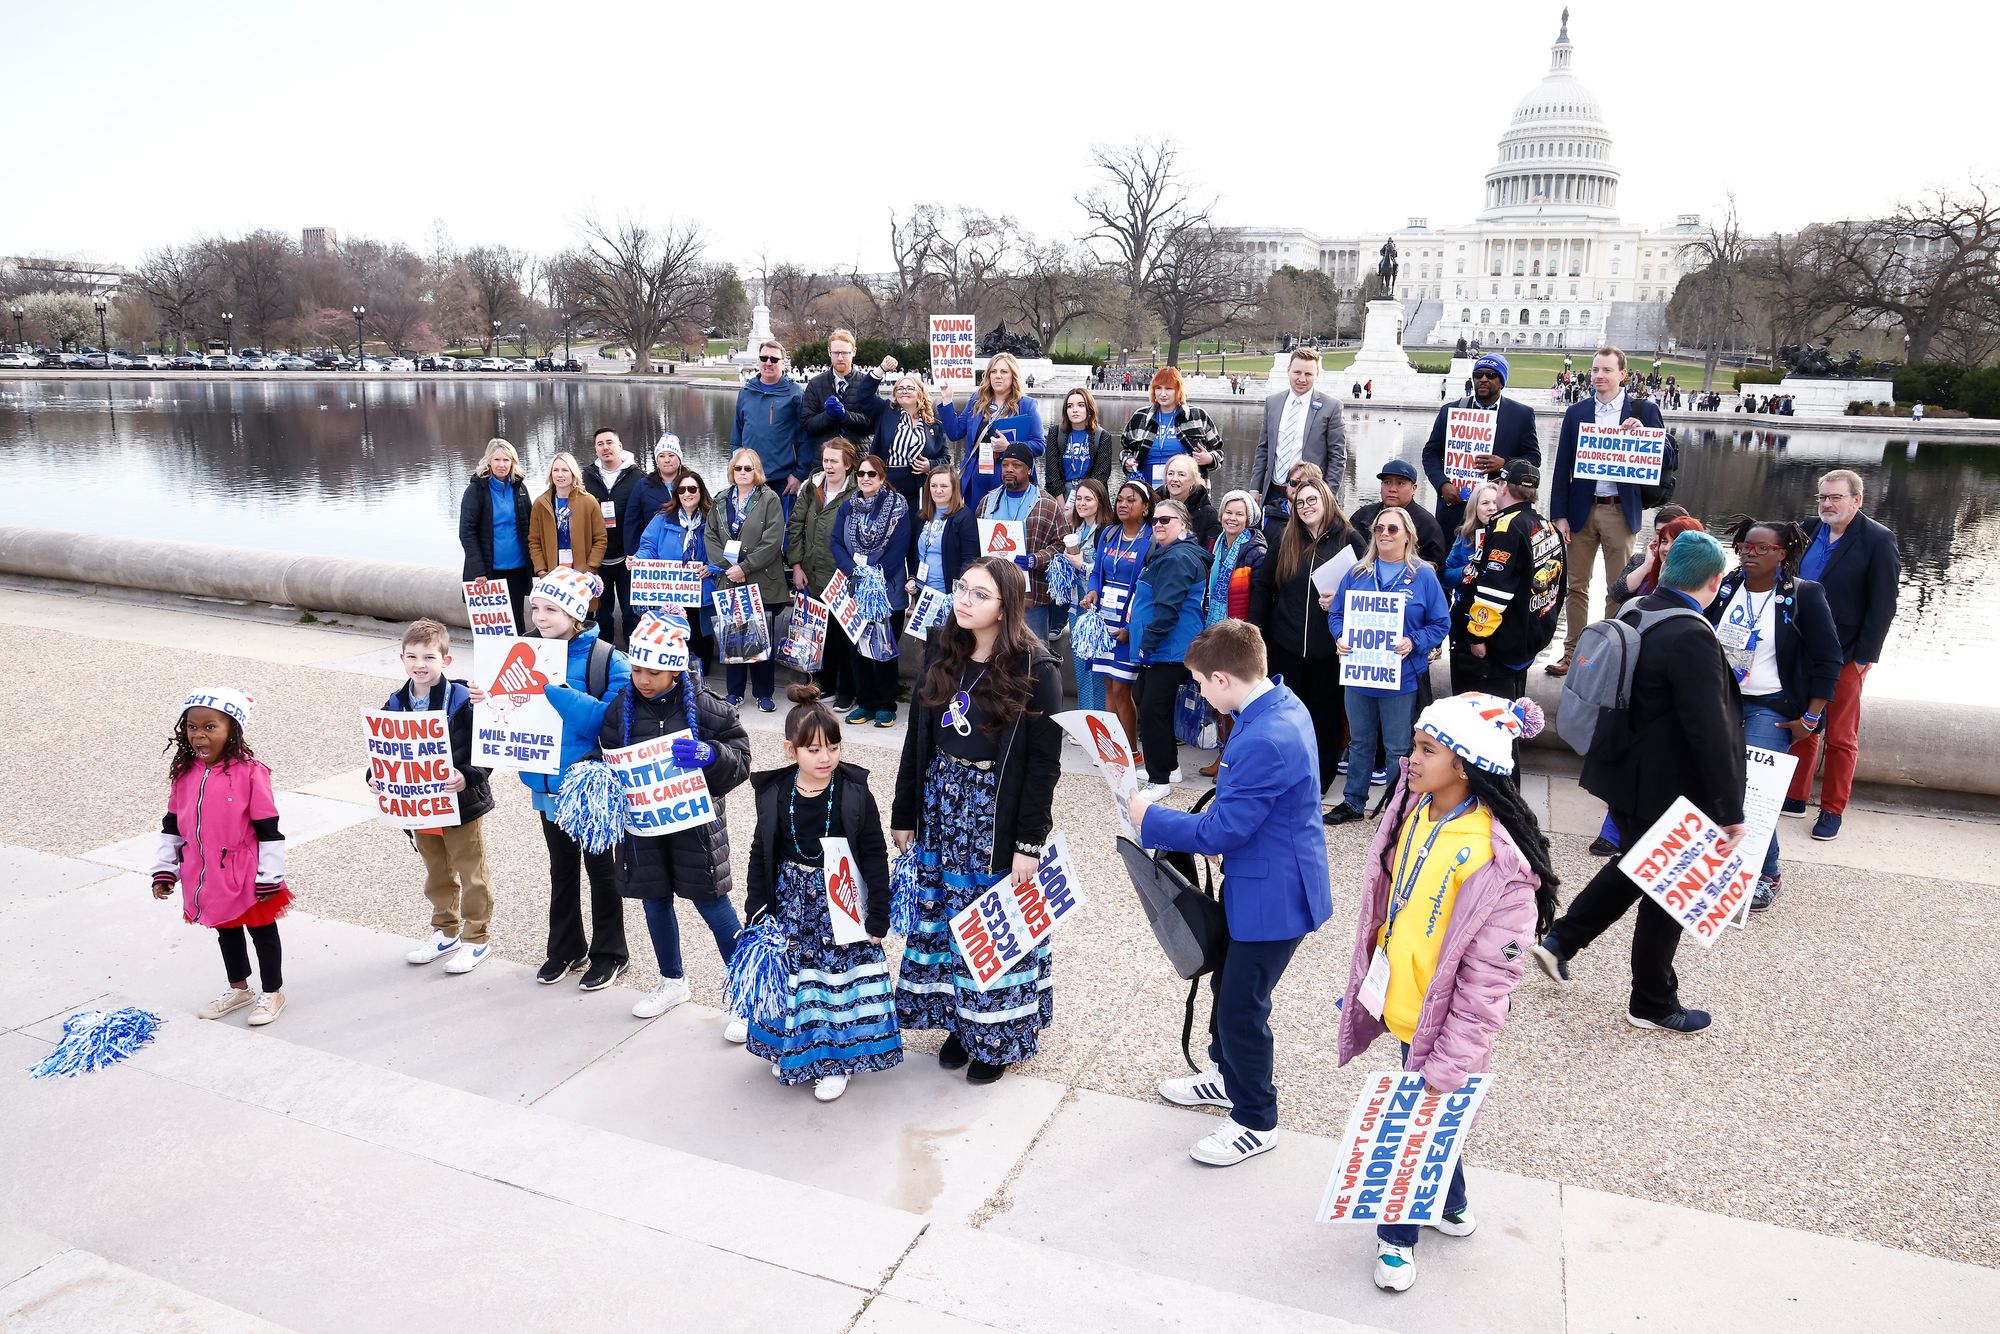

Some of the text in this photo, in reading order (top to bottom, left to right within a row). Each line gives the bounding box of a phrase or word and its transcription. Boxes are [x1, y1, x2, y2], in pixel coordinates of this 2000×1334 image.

[933, 319, 972, 332] YOUNG
[932, 334, 956, 343] PEOPLE
[933, 344, 972, 358] DYING
[934, 367, 973, 378] CANCER
[1450, 424, 1492, 442] YOUNG
[1598, 427, 1627, 436] WON'T
[1630, 429, 1650, 437] GIVE
[1448, 440, 1490, 452] PEOPLE ARE
[1580, 436, 1662, 454] PRIORITIZE
[1446, 452, 1476, 470] DYIN
[1577, 450, 1661, 465] COLORECTAL CANCER
[1576, 462, 1658, 480] RESEARCH
[1488, 549, 1510, 564] 22
[633, 569, 700, 582] PRIORITIZE
[466, 582, 505, 598] EQUAL
[533, 582, 575, 606] FIGHT
[632, 582, 673, 590] COLORECTAL
[750, 585, 756, 598] WE
[824, 570, 846, 603] EQUA
[470, 595, 508, 607] ACCESS
[632, 592, 699, 602] RESEARCH
[1351, 596, 1398, 613] WHERE
[796, 596, 826, 620] YUNG
[840, 597, 858, 625] EQU
[911, 592, 934, 632] WHERE
[472, 612, 512, 627] EQUAL
[815, 618, 826, 628] ARE
[1350, 613, 1398, 628] THERE IS
[1348, 628, 1397, 651] HOPE
[658, 654, 685, 666] CRC
[1348, 650, 1396, 666] THERE IS
[498, 656, 538, 692] HOPE
[1344, 664, 1396, 683] FUTURE
[366, 716, 444, 740] YOUNG
[479, 728, 554, 746] WILL NEVER
[368, 739, 447, 760] PEOPLE ARE
[482, 744, 550, 761] BE SILENT
[603, 741, 670, 764] ON'T GIVE
[372, 757, 450, 784] DYING
[388, 782, 445, 798] COLORECTA
[654, 776, 706, 802] CANCER
[378, 795, 454, 817] CANCER
[1704, 828, 1718, 844] OF
[1633, 812, 1703, 882] CANCER
[1038, 844, 1076, 920] HOPE
[1683, 854, 1744, 925] PEOPLE ARE
[1014, 876, 1052, 939] EQUA
[1697, 870, 1754, 937] YOUNG
[980, 892, 1022, 962] ACCESS
[958, 908, 1002, 982] EQUAL
[1330, 1076, 1394, 1220] WE WON'T GIVE UP
[1352, 1076, 1425, 1220] PRIORITIZE
[1408, 1077, 1482, 1220] RESEARCH
[1382, 1092, 1442, 1223] COLORECTAL CANC
